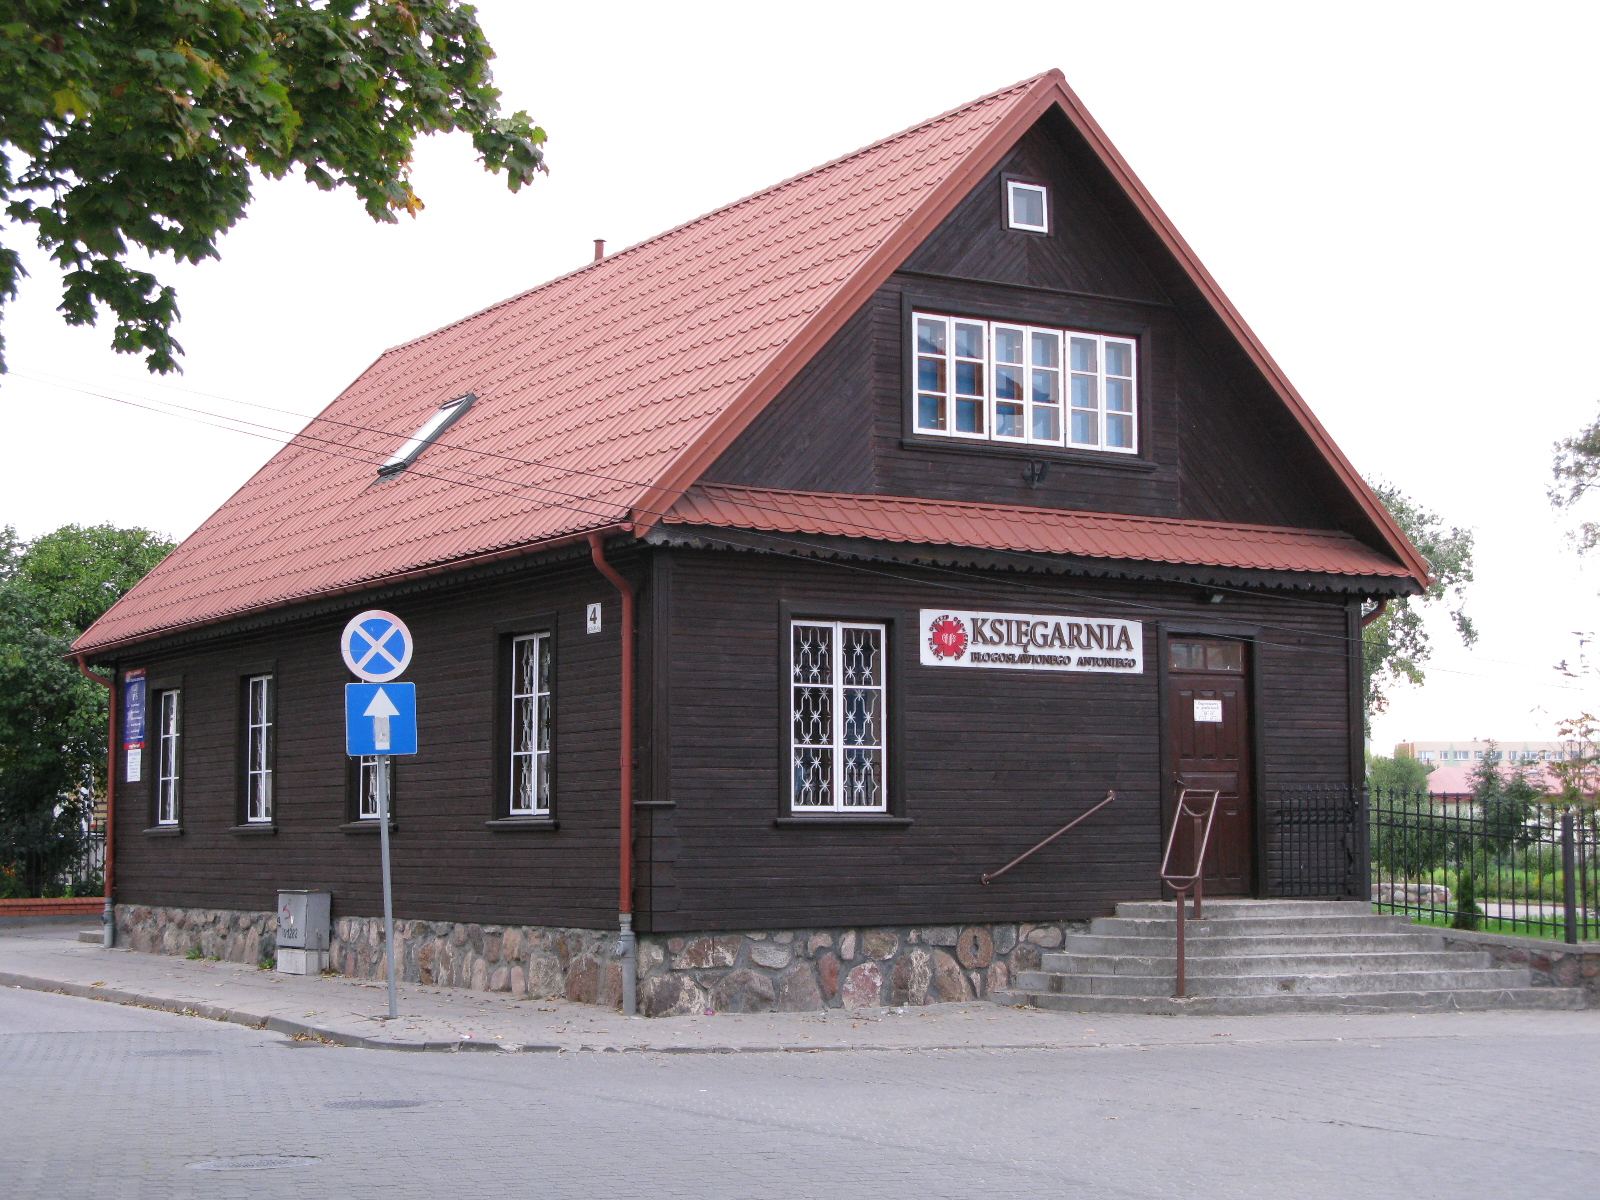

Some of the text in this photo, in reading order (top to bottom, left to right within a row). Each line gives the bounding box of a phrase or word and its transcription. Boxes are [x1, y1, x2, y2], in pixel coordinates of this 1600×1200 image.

[589, 606, 598, 625] 4
[970, 617, 1135, 653] KSIĘGARNIA
[1076, 656, 1137, 669] ANTONIEGO
